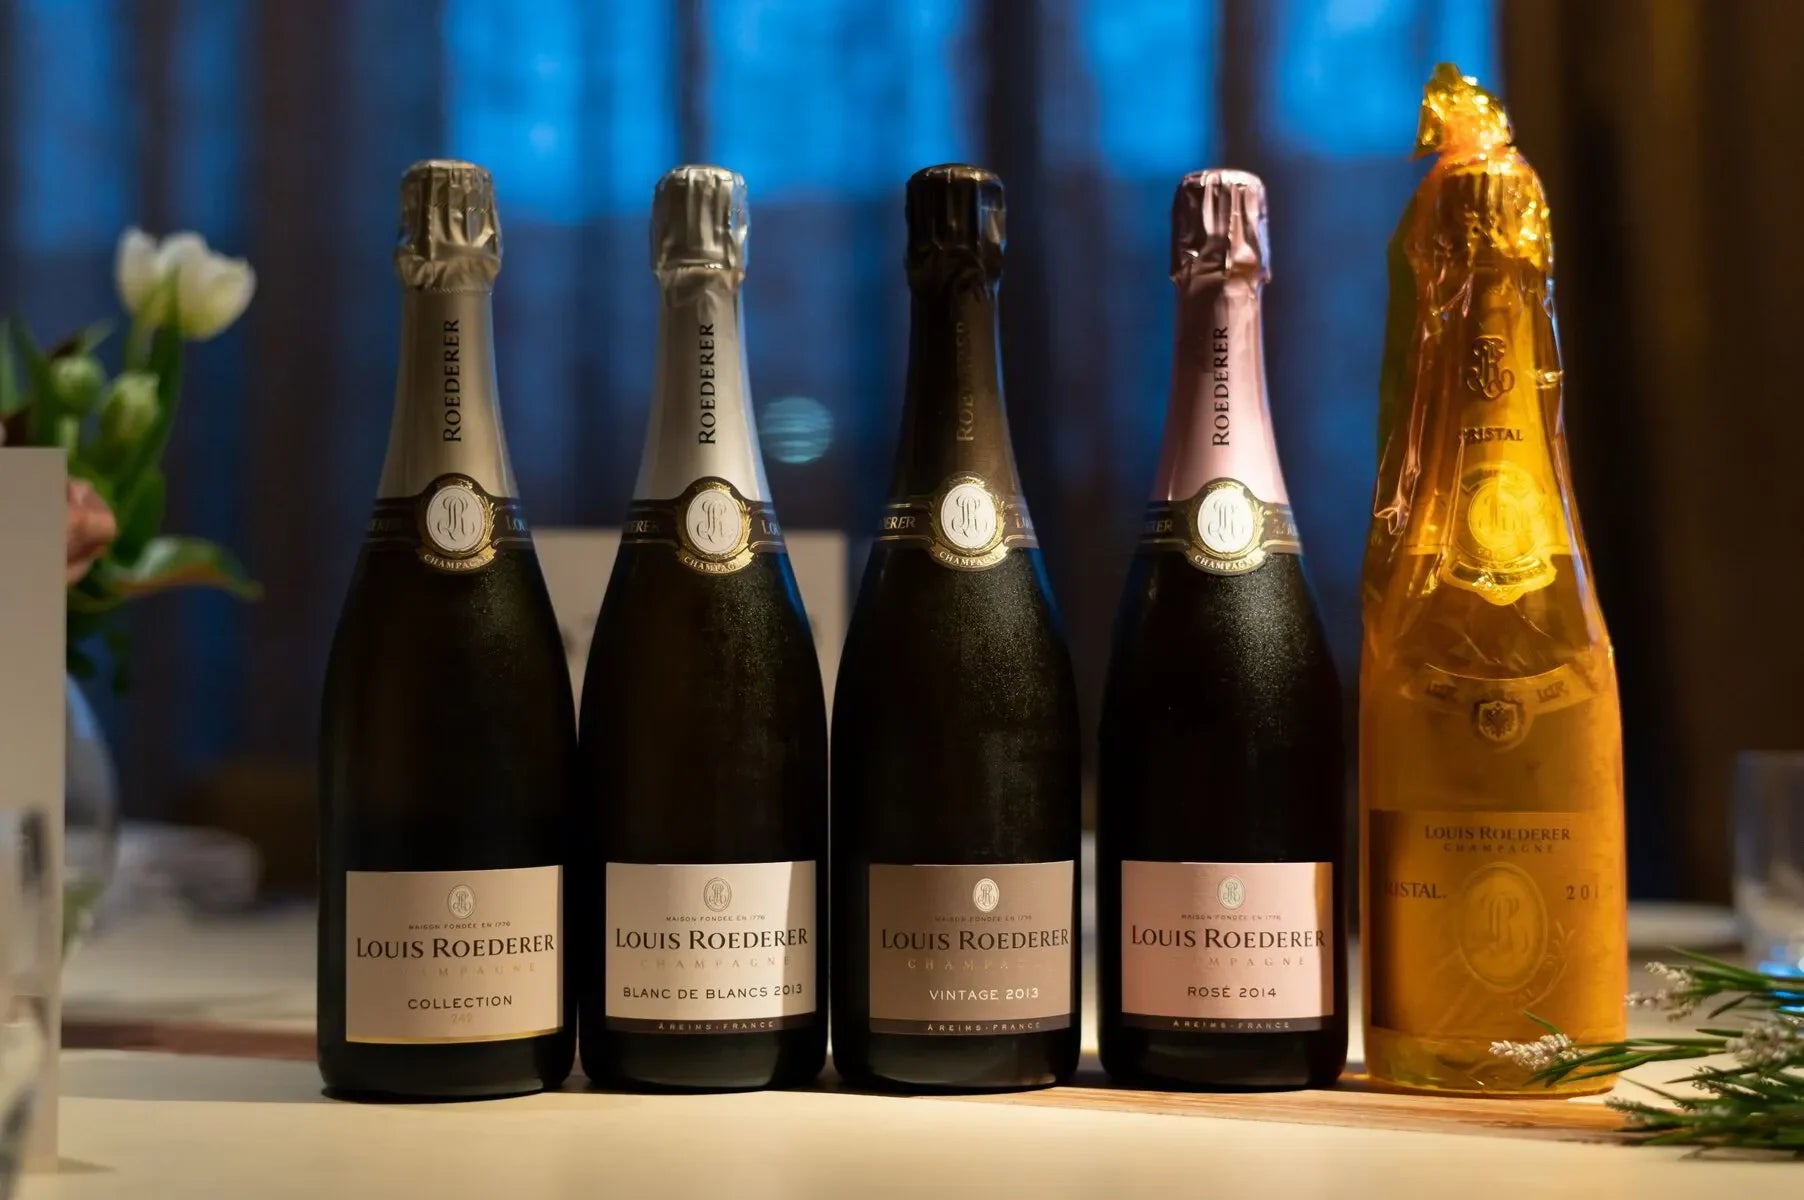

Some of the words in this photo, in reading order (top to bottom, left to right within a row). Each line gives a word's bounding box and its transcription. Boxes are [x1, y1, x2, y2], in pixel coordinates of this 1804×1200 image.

[443, 319, 461, 442] ROEDERER
[699, 323, 716, 444] ROEDERER
[1212, 326, 1230, 446] ROEDERER
[1425, 825, 1474, 840] LOUIS
[1480, 825, 1570, 841] ROEDERER
[356, 937, 424, 959] LOUIS
[432, 934, 555, 958] ROEDERER
[616, 928, 680, 949] LOUIS
[689, 927, 808, 949] ROEDERER
[882, 929, 950, 950] LOUIS
[959, 928, 1069, 950] ROEDERER
[1131, 925, 1196, 947] LOUIS
[1204, 928, 1325, 948] ROEDERER
[408, 995, 512, 1010] COLLECTION
[623, 987, 671, 999] BLANC
[678, 989, 698, 1000] DE
[706, 987, 768, 999] BLANCS
[774, 984, 802, 996] 2013
[929, 989, 999, 1000] VINTAGE
[1006, 988, 1039, 1000] 2013
[1187, 985, 1231, 998] ROSÉ
[1239, 988, 1276, 998] 2014
